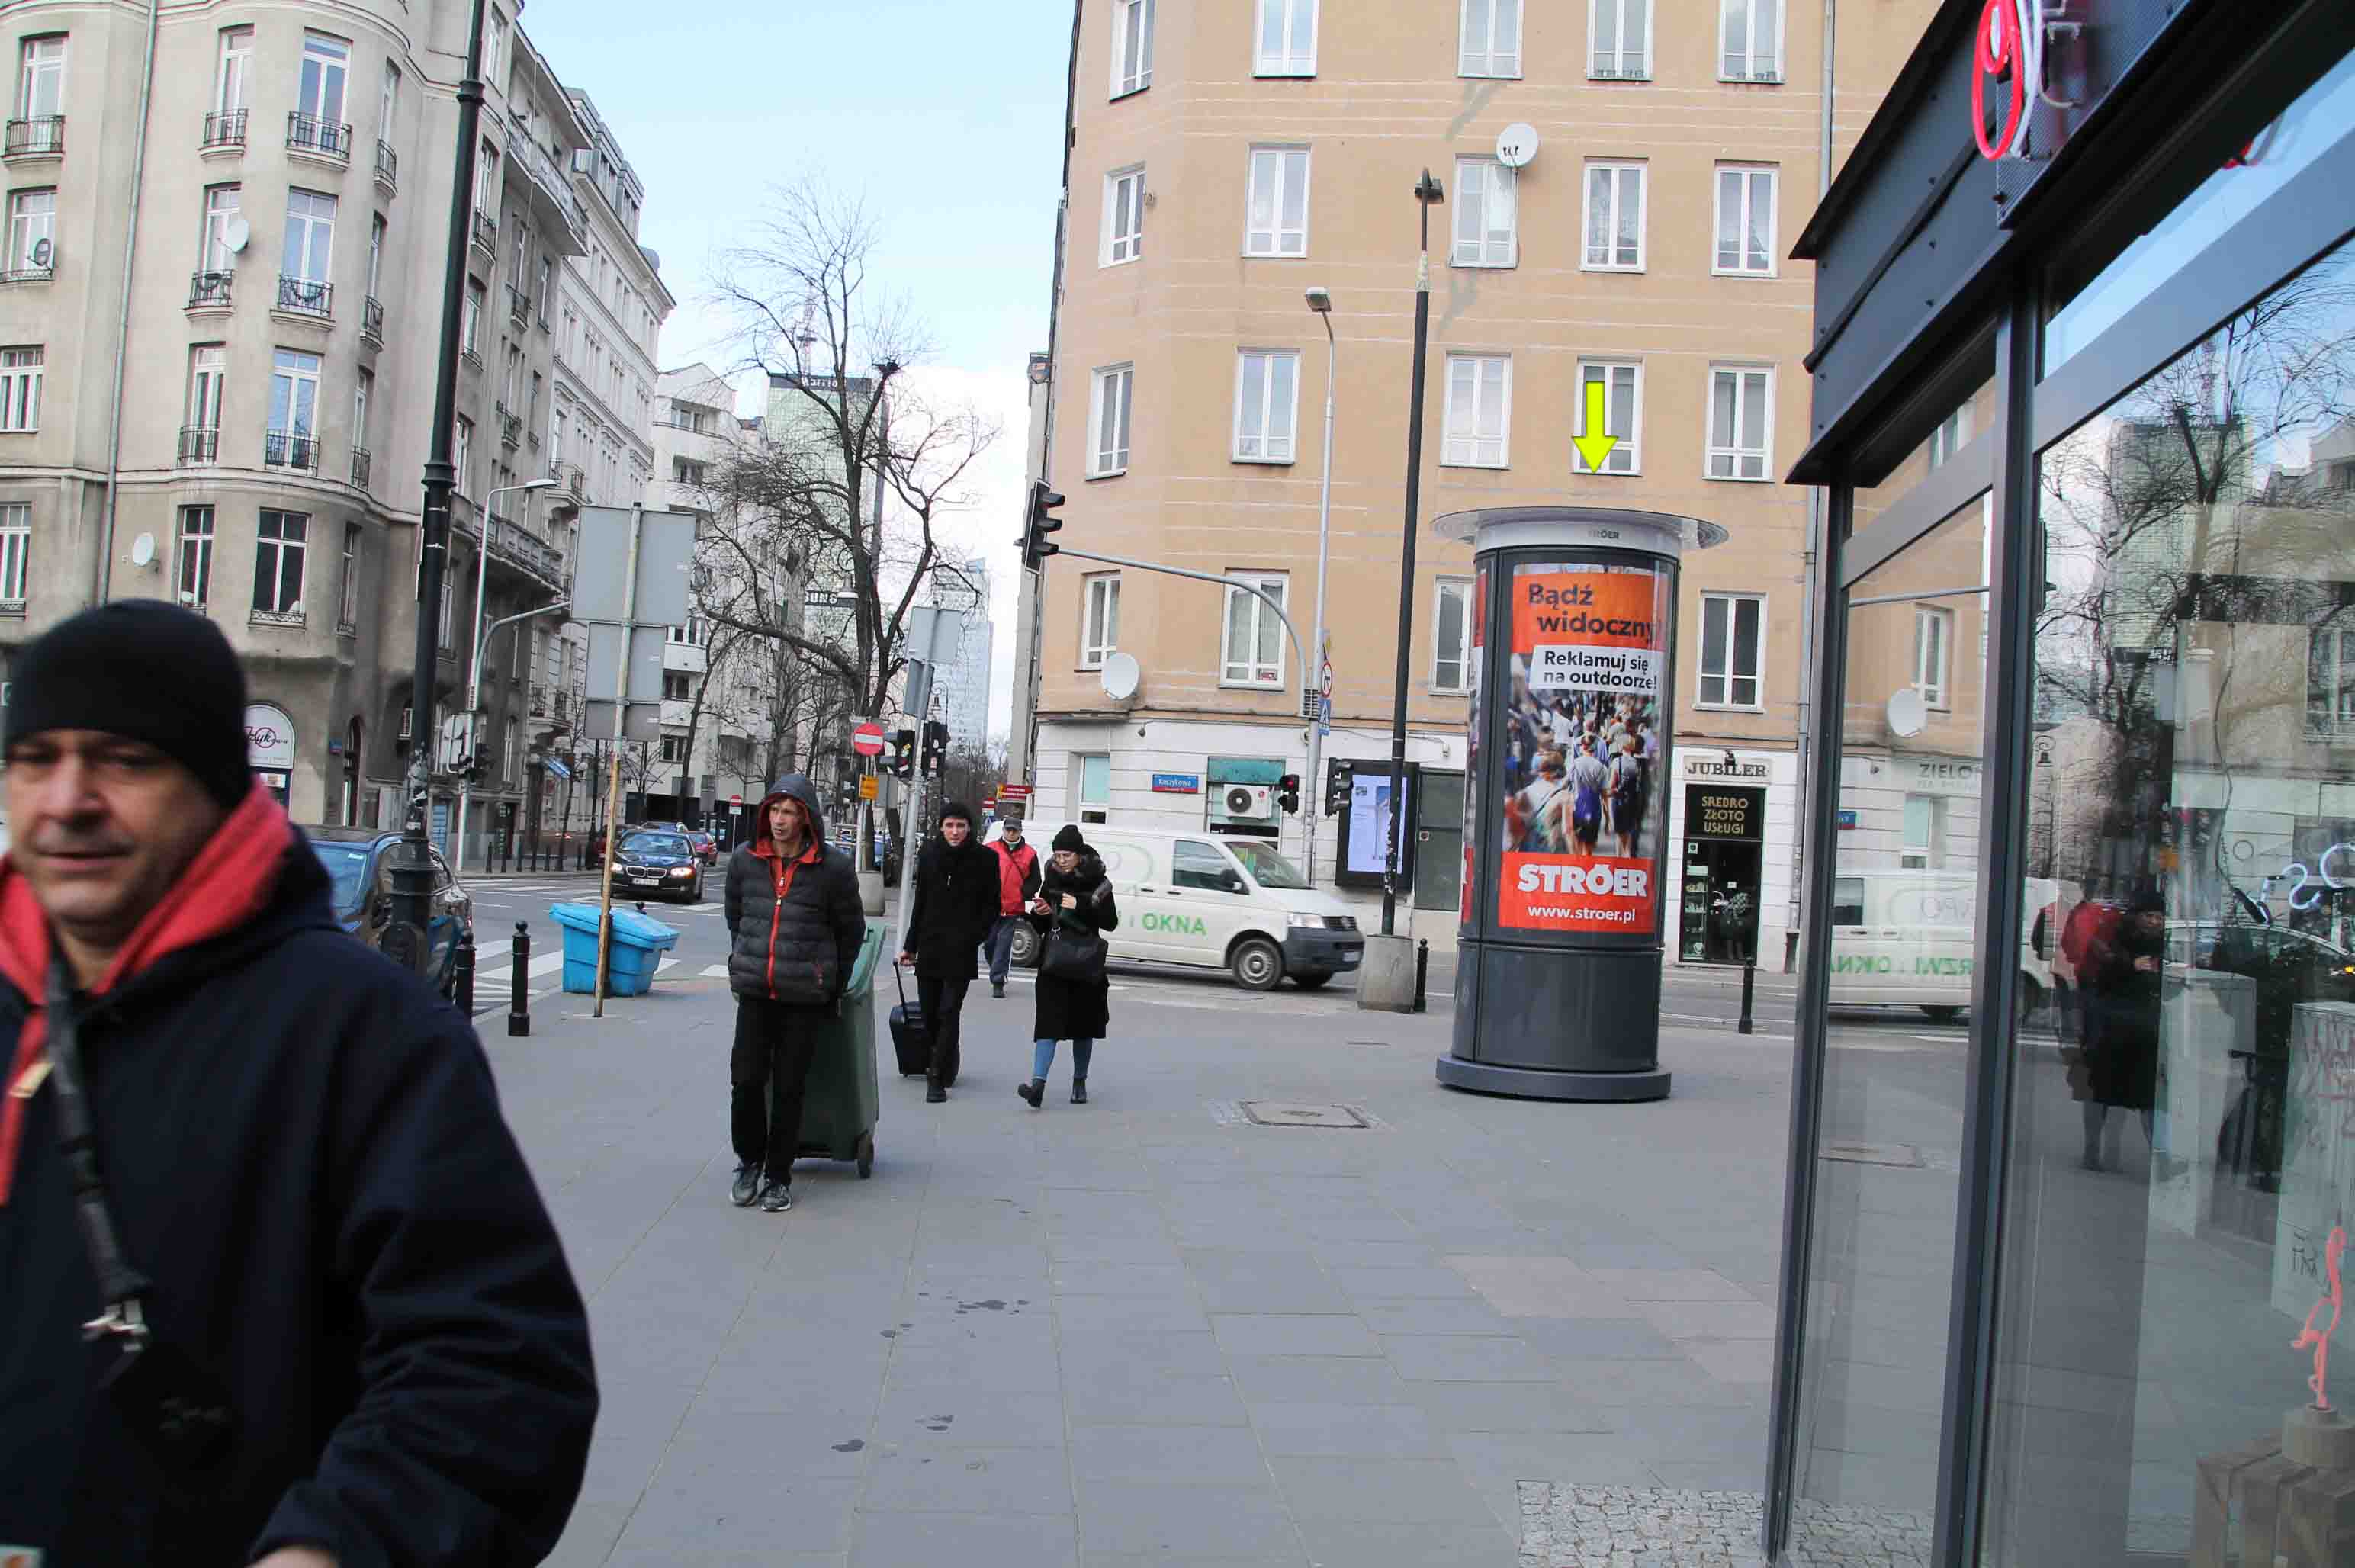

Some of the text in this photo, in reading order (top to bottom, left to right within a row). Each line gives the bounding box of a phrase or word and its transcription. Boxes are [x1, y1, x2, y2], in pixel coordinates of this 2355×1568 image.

[1528, 583, 1593, 610] Bądź
[1544, 651, 1649, 675] Reklamuj się
[1543, 671, 1565, 683] na
[1687, 762, 1768, 777] JUBILER
[1701, 796, 1749, 808] SREBRO
[1703, 808, 1745, 821] ZŁOTO
[1704, 821, 1744, 834] USŁUGI
[1517, 863, 1648, 898] STRÖER
[1528, 906, 1635, 924] www.stroer.pl
[1142, 912, 1208, 936] OKNA
